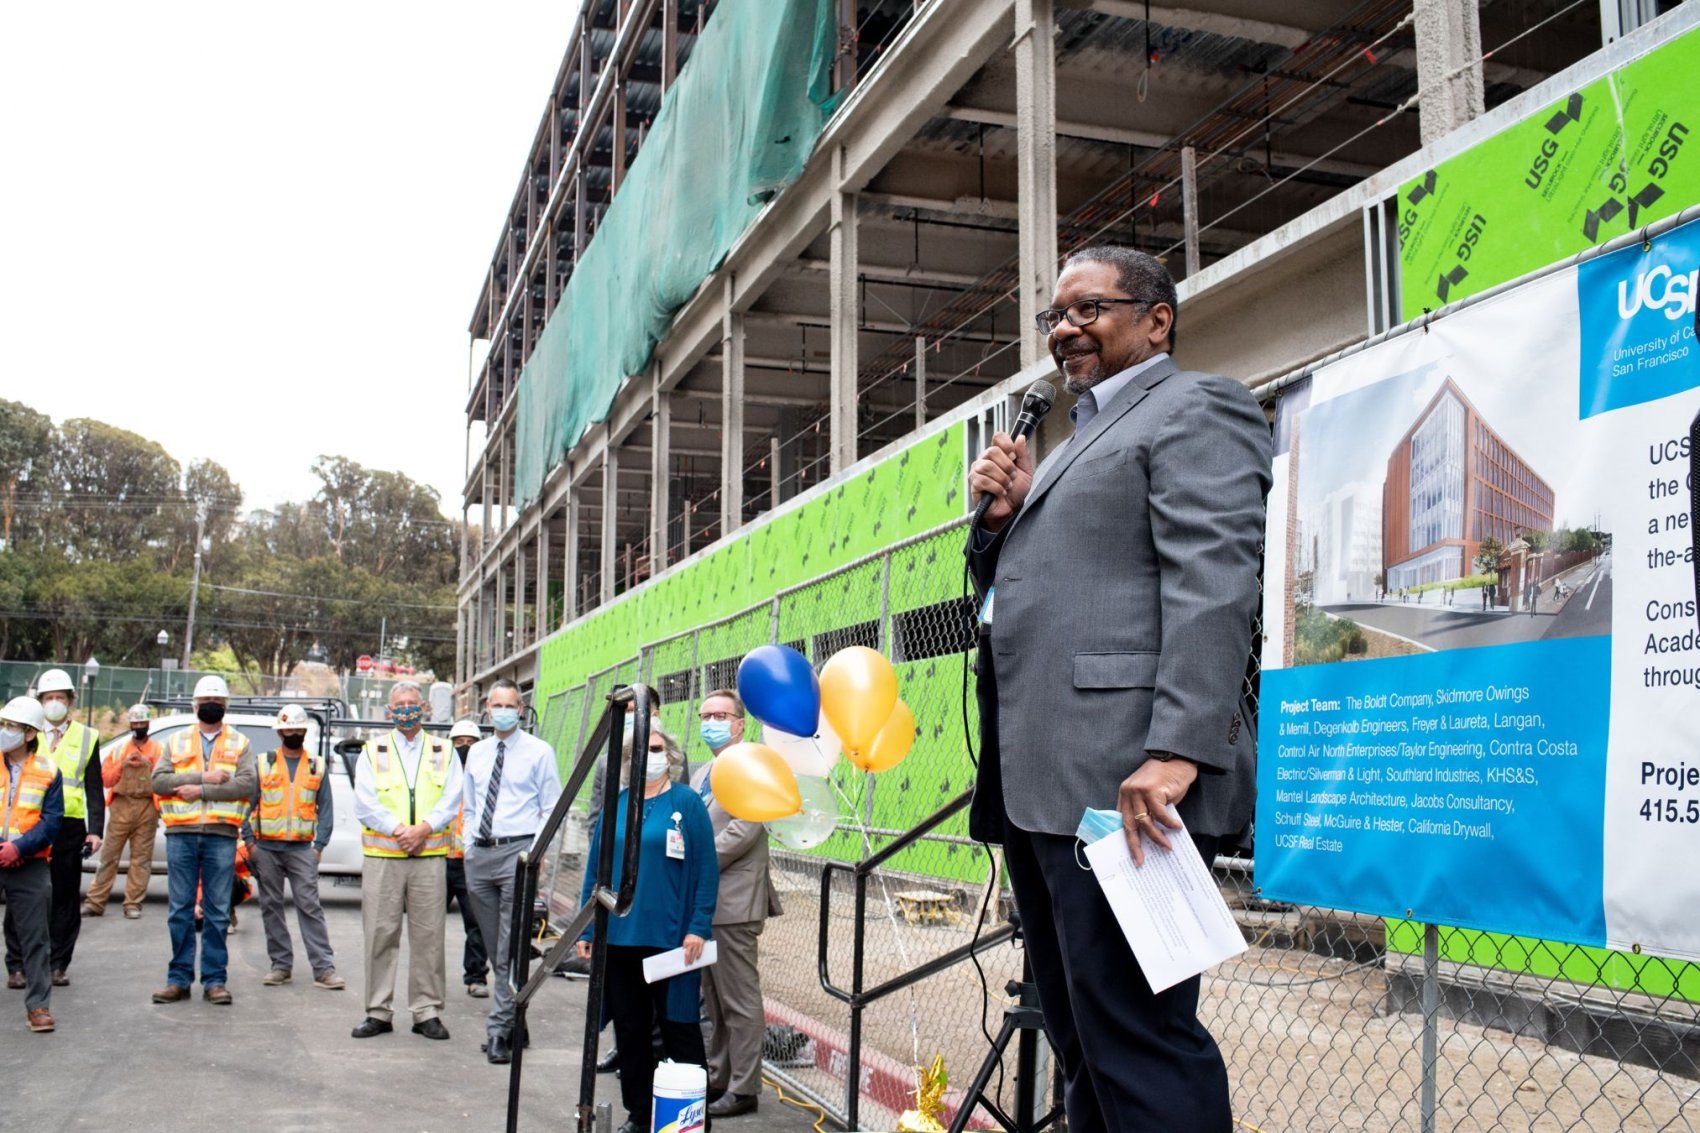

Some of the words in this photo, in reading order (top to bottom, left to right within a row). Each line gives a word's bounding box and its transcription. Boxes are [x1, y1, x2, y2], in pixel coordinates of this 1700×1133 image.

[1525, 138, 1559, 189] USG
[1648, 122, 1690, 179] USG
[1456, 214, 1487, 262] USG
[1614, 336, 1668, 361] University
[1670, 330, 1680, 344] of
[1612, 364, 1633, 377] San
[1638, 346, 1689, 370] Francisco
[1648, 478, 1678, 500] the
[1648, 518, 1659, 534] a
[1666, 511, 1692, 532] ne
[1647, 546, 1694, 569] the-a
[1646, 600, 1695, 622] Cons
[1280, 700, 1309, 715] Project
[1311, 698, 1341, 712] Team:
[1346, 696, 1362, 710] The
[1364, 694, 1387, 708] Boldt
[1390, 693, 1434, 708] Company,
[1436, 688, 1483, 704] Skidmore
[1486, 685, 1530, 704] Owings
[1280, 723, 1285, 736] &
[1314, 720, 1360, 738] Degenkolb
[1361, 719, 1409, 736] Engineers,
[1412, 717, 1438, 734] Freyer
[1440, 715, 1446, 730] &
[1450, 714, 1490, 730] Laureta,
[1494, 712, 1545, 731] Langan,
[1278, 744, 1305, 758] Control
[1308, 745, 1320, 757] Air
[1322, 744, 1346, 757] North
[1346, 742, 1426, 760] Enterprises/Taylor
[1429, 740, 1486, 760] Engineering,
[1490, 739, 1532, 756] Contra
[1537, 738, 1578, 756] Costa
[1348, 767, 1355, 781] &
[1357, 768, 1383, 784] Light,
[1386, 767, 1432, 782] Southland
[1435, 768, 1483, 784] Industries,
[1487, 767, 1539, 786] KHS&S,
[1642, 762, 1700, 791] Proje
[1276, 789, 1303, 803] Mantel
[1306, 790, 1347, 806] Landscape
[1350, 792, 1408, 808] Architecture,
[1411, 793, 1444, 808] Jacobs
[1447, 794, 1515, 814] Consultancy,
[1640, 798, 1700, 824] 415.5
[1275, 811, 1301, 826] Schuff
[1324, 814, 1361, 829] McGuire
[1364, 816, 1371, 830] &
[1373, 818, 1405, 834] Hester,
[1408, 818, 1450, 835] California
[1453, 820, 1495, 840] Drywall,
[1275, 834, 1299, 848] UCSF
[1316, 837, 1343, 852] Estate
